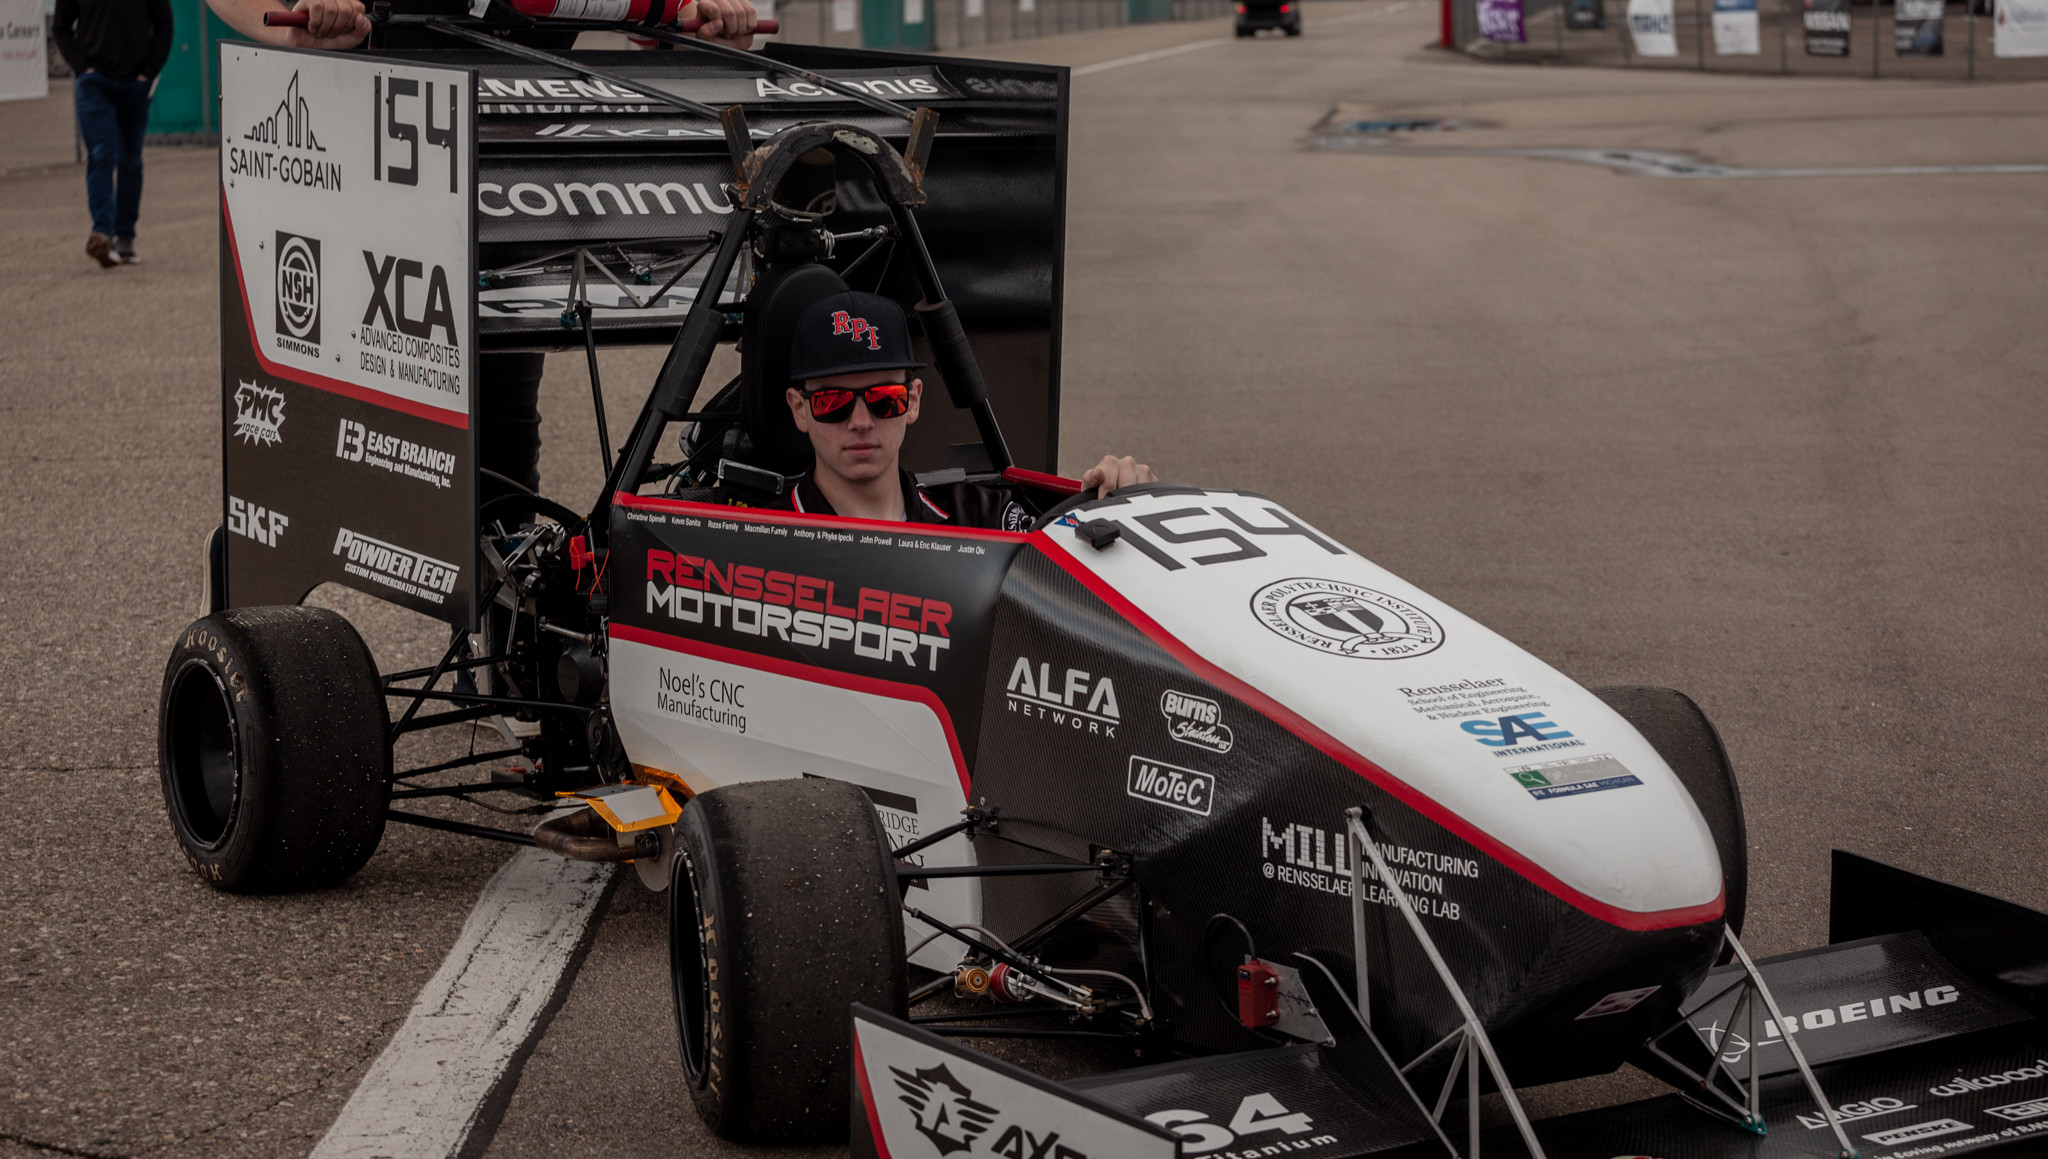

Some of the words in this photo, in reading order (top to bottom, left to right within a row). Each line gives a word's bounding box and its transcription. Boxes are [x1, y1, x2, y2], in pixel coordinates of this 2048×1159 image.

[374, 75, 458, 194] 154
[230, 147, 342, 193] SAINT-GOBAIN
[361, 250, 459, 347] XCA
[276, 337, 320, 358] SIMMONS
[360, 326, 404, 354] ADVANCED
[405, 332, 461, 369] COMPOSITES
[831, 311, 881, 350] RPI
[360, 351, 387, 376] DESIGN
[389, 359, 395, 378] &
[398, 360, 461, 396] MANUFACTURING
[239, 387, 281, 426] PMC
[365, 452, 394, 473] Engineering
[366, 430, 401, 458] EAST
[399, 440, 456, 475] BRANCH
[228, 495, 289, 549] SKF
[627, 512, 648, 522] Christine
[648, 514, 667, 524] Spinelli
[722, 521, 739, 532] Family
[744, 523, 770, 534] Macmillan
[770, 526, 788, 537] Family
[793, 528, 815, 540] Anthony
[860, 535, 873, 544] John
[873, 536, 892, 546] Powell
[898, 538, 913, 549] Laura
[930, 541, 952, 552] Klauser
[957, 544, 975, 554] Justin
[1112, 507, 1348, 571] 154
[344, 562, 369, 578] CUSTOM
[368, 571, 417, 595] POWDERCOATED
[416, 585, 445, 605] FINISHES
[647, 548, 953, 637] RENSSELAER
[646, 580, 950, 672] MOTORSPORT
[1380, 643, 1415, 656] 1824
[659, 666, 705, 698] Noel's
[710, 679, 744, 707] CNC
[1006, 656, 1120, 718] ALFA
[1397, 676, 1507, 698] Rensselaer
[1408, 696, 1447, 706] School
[1447, 693, 1458, 701] of
[1461, 686, 1528, 700] Engineering
[657, 692, 746, 733] Manufacturing
[1008, 700, 1115, 738] NETWORK
[1460, 711, 1575, 747] SAE
[1492, 739, 1585, 758] INTERNATIONAL
[1135, 764, 1205, 806] MoTeC
[1262, 817, 1352, 877] MILL
[1262, 862, 1275, 879] @
[1432, 901, 1460, 921] LAB
[1764, 985, 1961, 1038] BOEING
[1878, 1121, 1960, 1142] PENSKE
[1944, 1132, 2000, 1149] memory
